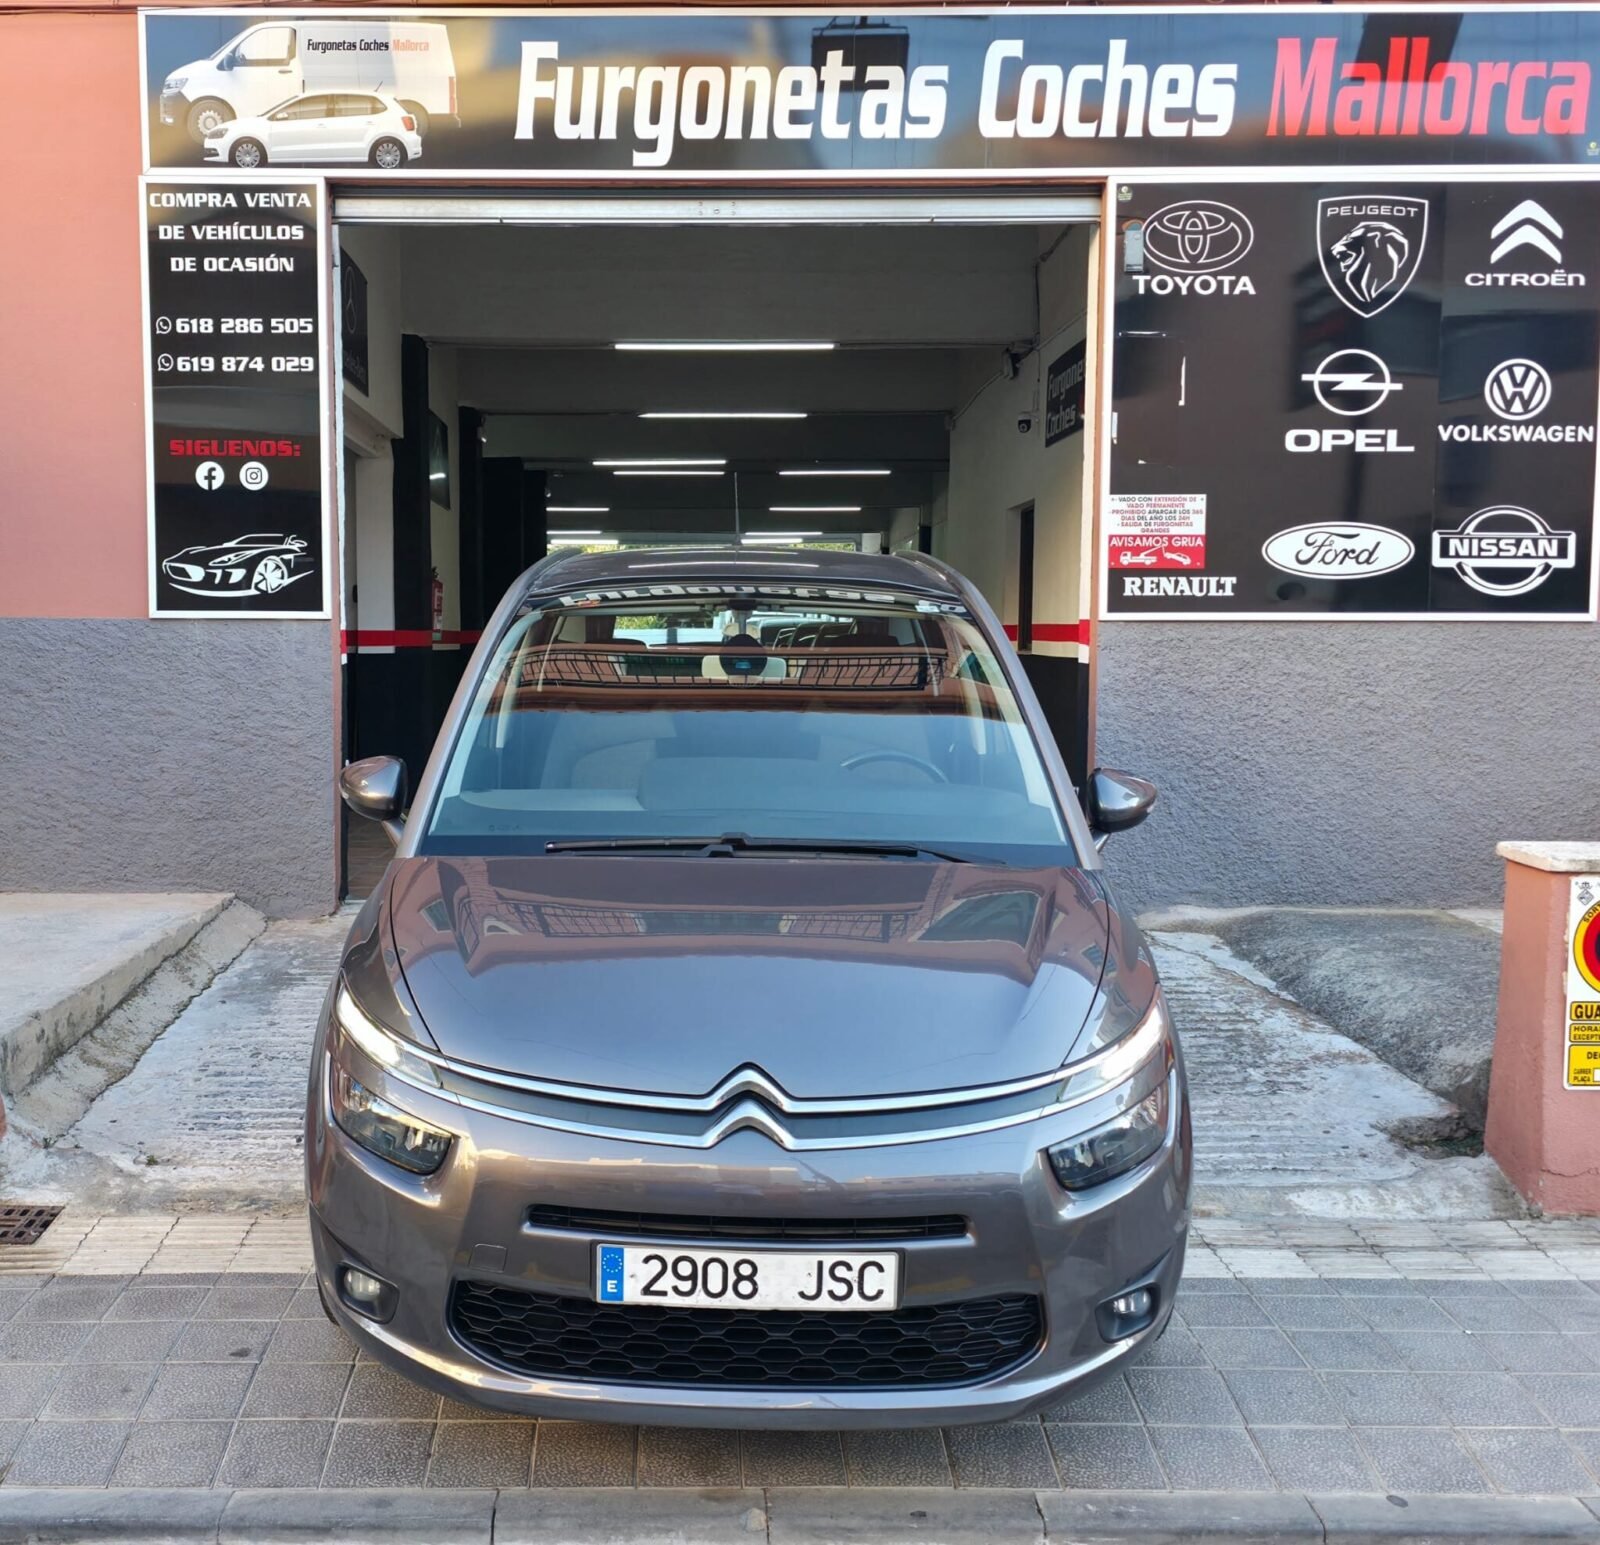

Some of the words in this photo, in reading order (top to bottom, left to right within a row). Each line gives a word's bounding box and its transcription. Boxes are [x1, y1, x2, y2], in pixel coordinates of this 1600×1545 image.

[307, 39, 357, 54] Furgonetas
[359, 39, 389, 51] Coches
[392, 39, 430, 52] Mallorca
[514, 41, 950, 167] Furgonetas
[978, 39, 1238, 138] Coches
[1265, 37, 1588, 137] Mallorca
[150, 193, 238, 208] COMPRA
[244, 193, 312, 208] VENTA
[1327, 205, 1419, 218] PEUGEOT
[159, 225, 185, 240] DE
[191, 222, 304, 240] VEHÍCULOS
[170, 257, 197, 272] DE
[203, 254, 294, 272] OCASIÓN
[1132, 275, 1256, 295] TOYOTA
[176, 318, 214, 333] 618
[221, 318, 263, 333] 286
[271, 318, 313, 333] 505
[177, 357, 215, 372] 619
[222, 357, 265, 372] 874
[271, 357, 314, 372] 029
[1047, 404, 1077, 440] Coches
[1285, 429, 1416, 453] OPEL
[1438, 424, 1594, 443] VOLKSWAGEN
[170, 439, 301, 457] SIGUENOS:
[1110, 536, 1169, 547] AVISAMOS
[1171, 536, 1204, 547] GRUA
[1295, 531, 1381, 565] Ford
[1449, 538, 1558, 557] NISSAN
[1123, 576, 1237, 597] RENAULT
[607, 1280, 618, 1292] E
[641, 1254, 759, 1300] 2908
[798, 1260, 885, 1302] JSC
